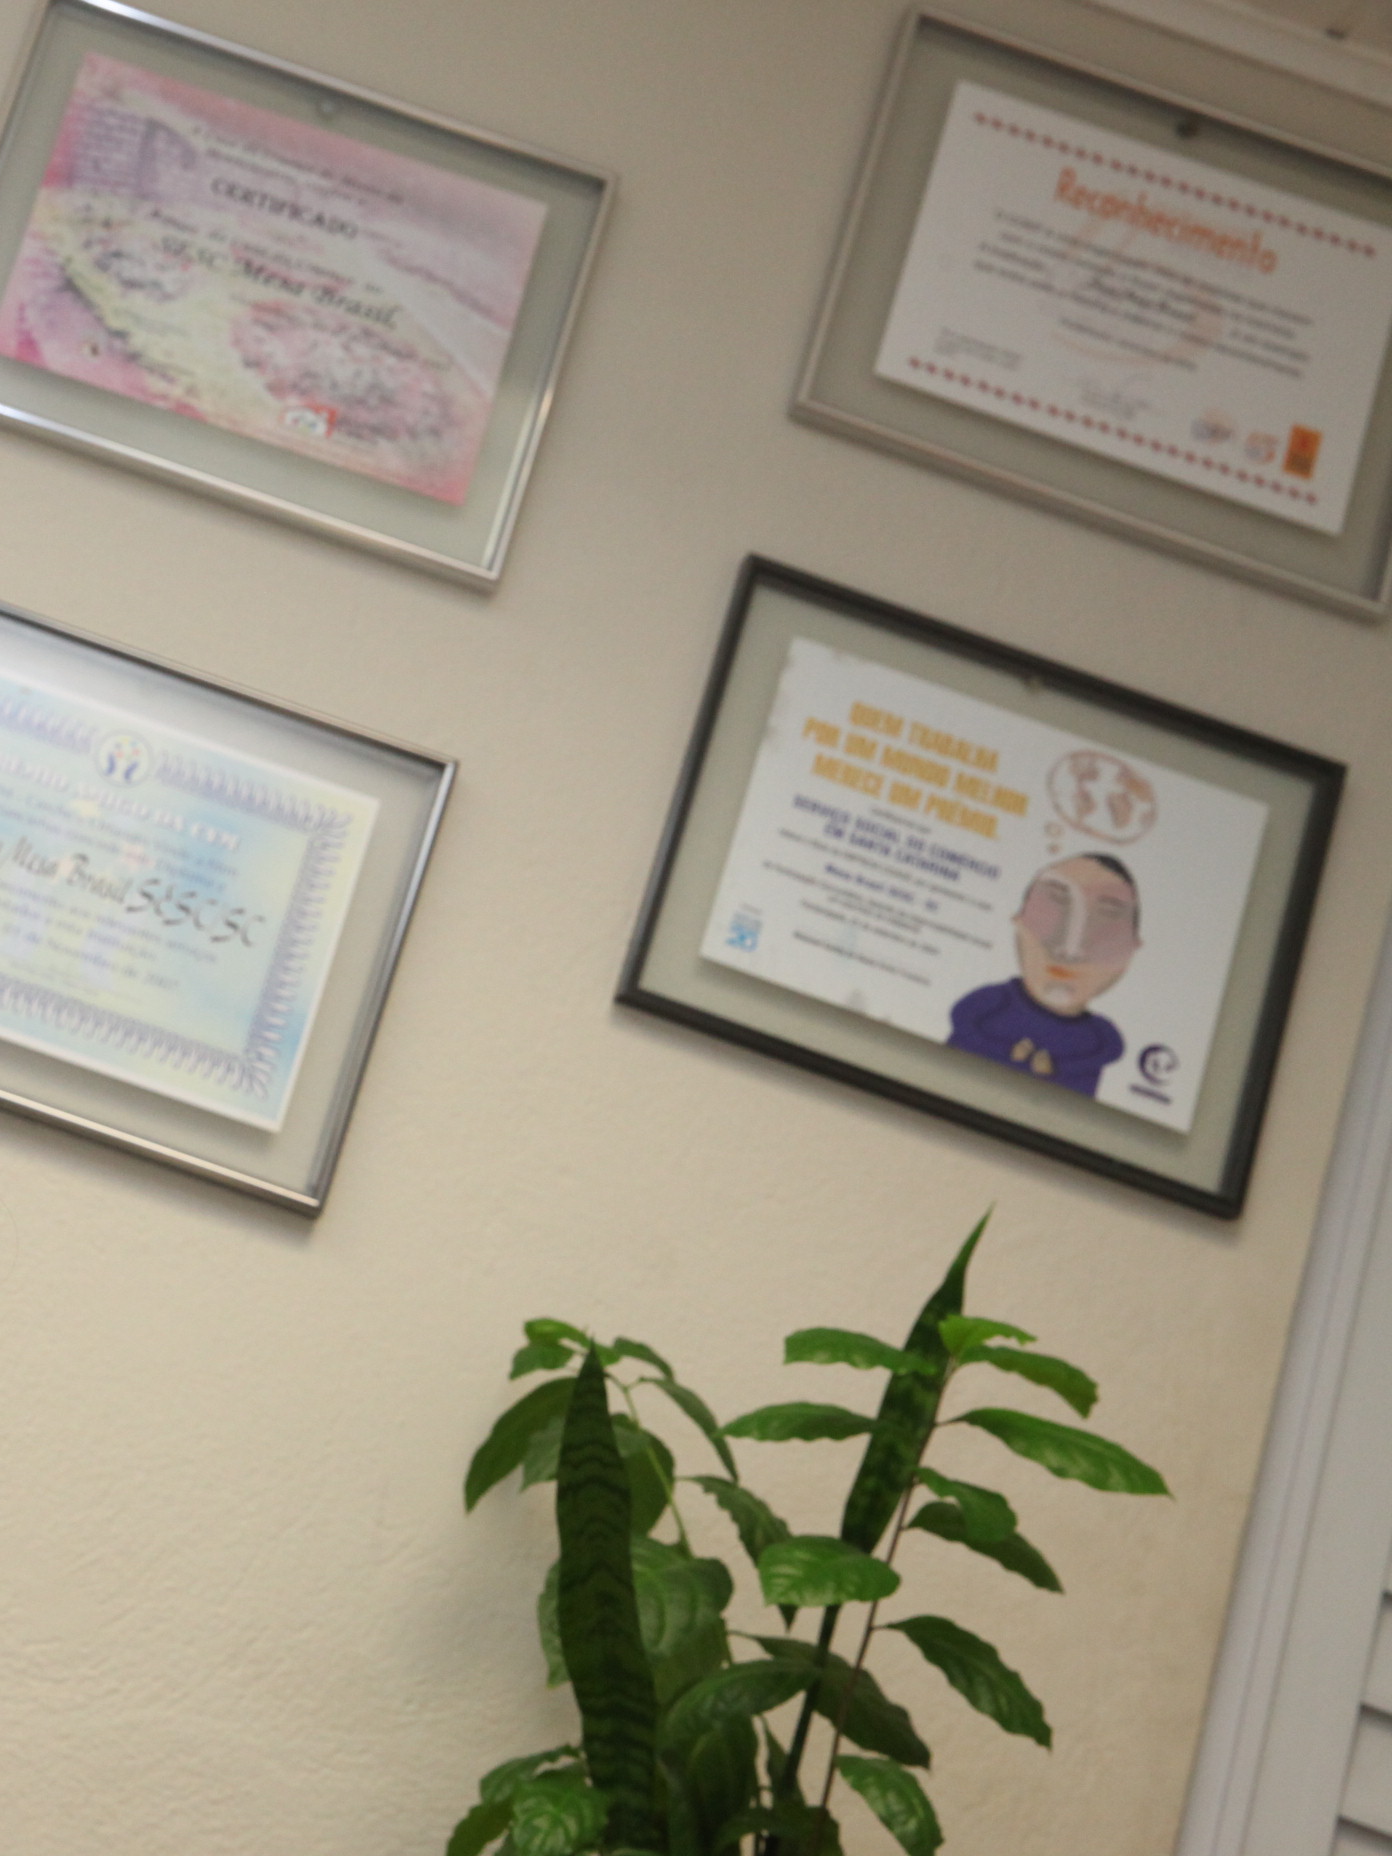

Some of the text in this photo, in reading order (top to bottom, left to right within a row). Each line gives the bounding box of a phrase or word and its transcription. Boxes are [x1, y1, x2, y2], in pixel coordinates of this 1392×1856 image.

[211, 179, 357, 238] CERTIFICADO
[1055, 166, 1280, 274] Reconhecimento
[803, 718, 841, 748] POR
[882, 747, 949, 787] MUNDO
[955, 773, 1027, 815] MELHOR
[850, 702, 998, 771] QUEM TRABALHA
[814, 754, 882, 795] MERECE
[0, 830, 62, 885] Mesa
[65, 852, 134, 910] Brasil
